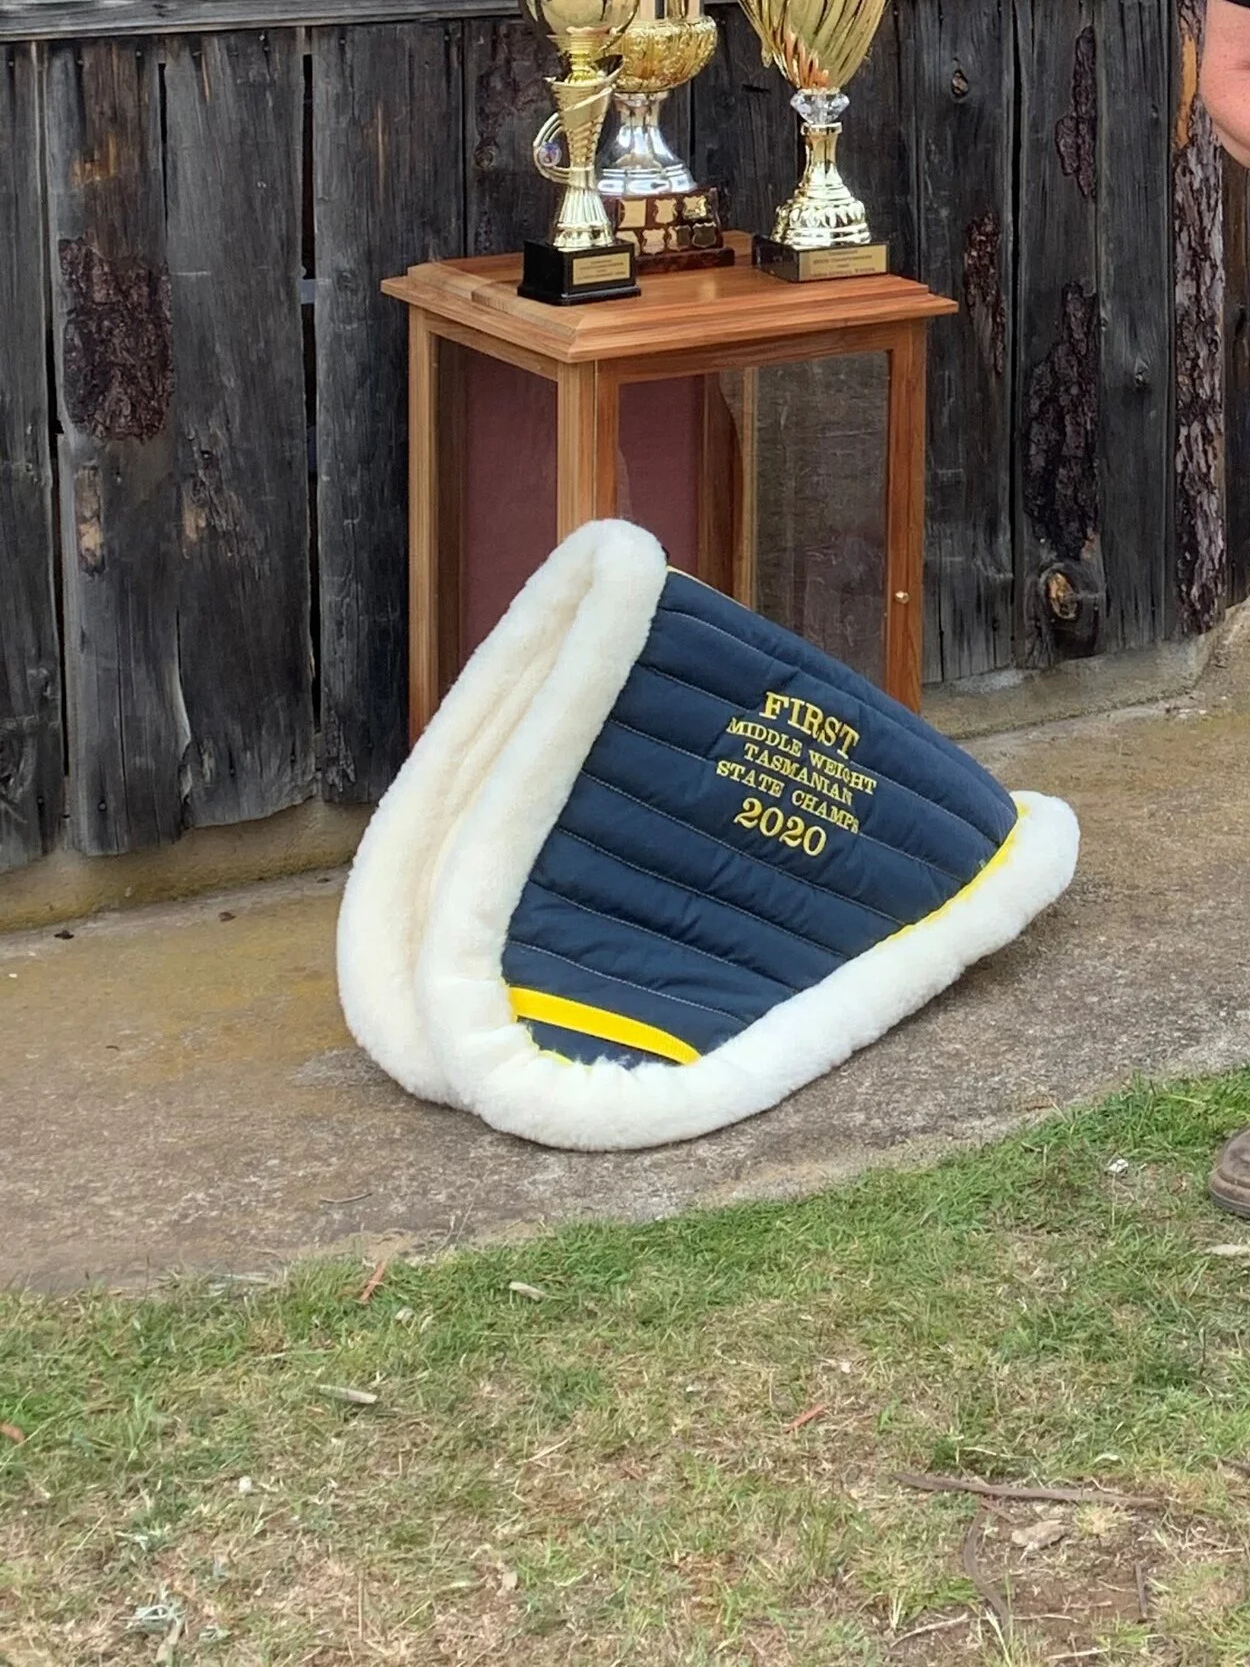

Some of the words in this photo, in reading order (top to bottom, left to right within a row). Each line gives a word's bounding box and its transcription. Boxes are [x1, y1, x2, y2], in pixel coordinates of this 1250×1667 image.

[726, 717, 803, 757] MIDDLE
[809, 750, 877, 795] WEIGHT
[759, 691, 860, 760] FIRST
[716, 760, 785, 798] STATE
[791, 790, 860, 834] CHAMPS
[744, 743, 853, 806] TASMANIAN
[733, 797, 827, 857] 2020
